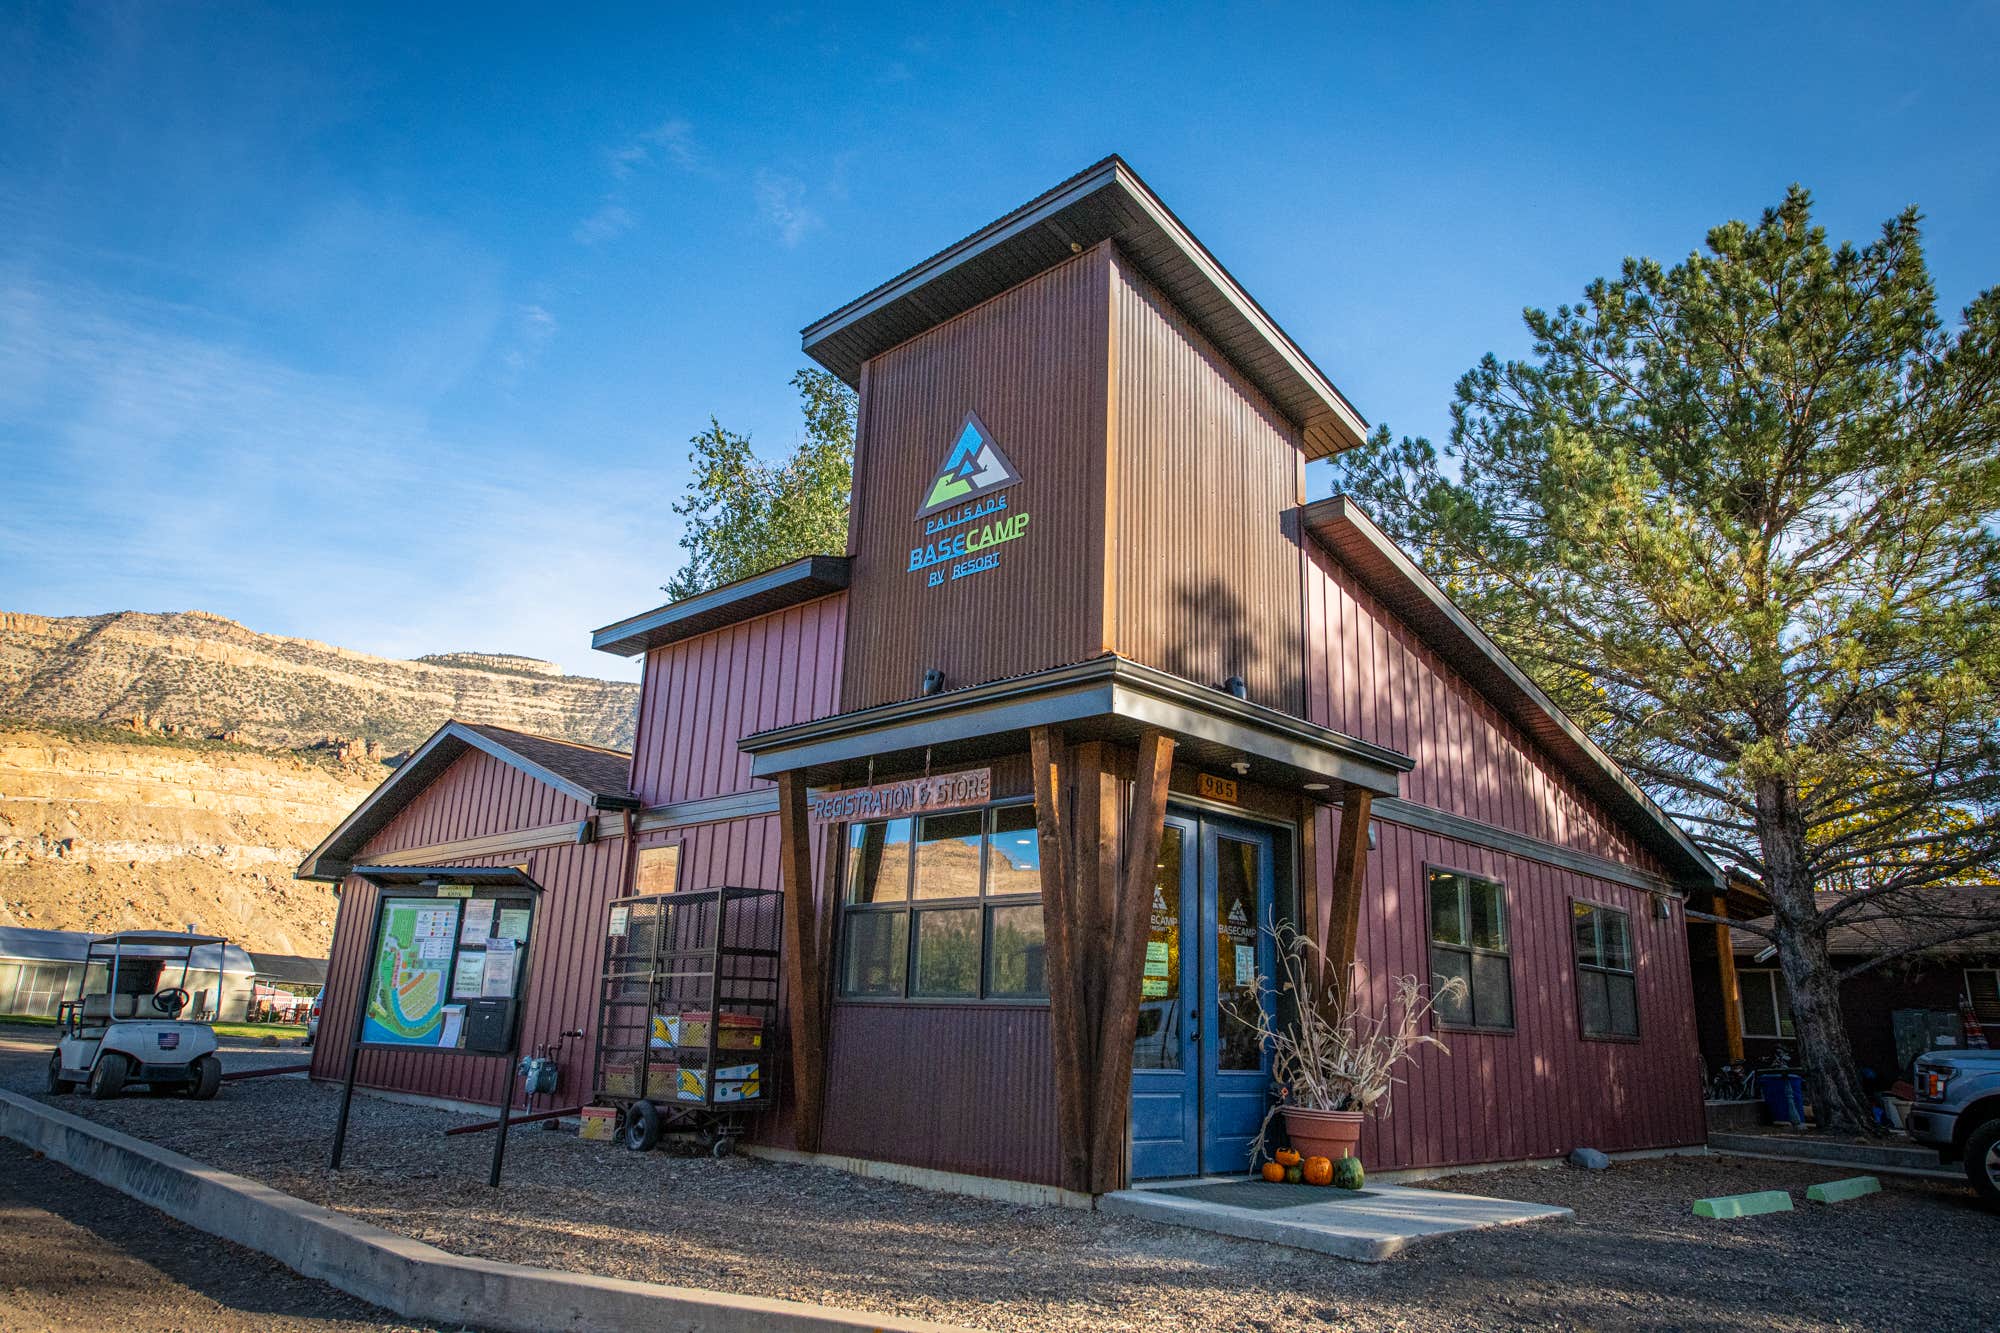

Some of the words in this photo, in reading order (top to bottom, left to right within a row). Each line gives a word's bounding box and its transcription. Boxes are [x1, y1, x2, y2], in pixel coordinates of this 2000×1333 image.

[925, 495, 1008, 535] PALISADE
[907, 512, 1030, 572] BASECAMP
[928, 569, 945, 587] RV
[951, 551, 1000, 580] RESORT
[813, 786, 915, 819] REGISTRATION
[918, 782, 931, 806] &
[936, 773, 990, 803] STORE
[1205, 777, 1233, 798] 985
[1218, 924, 1257, 938] BASECAMP
